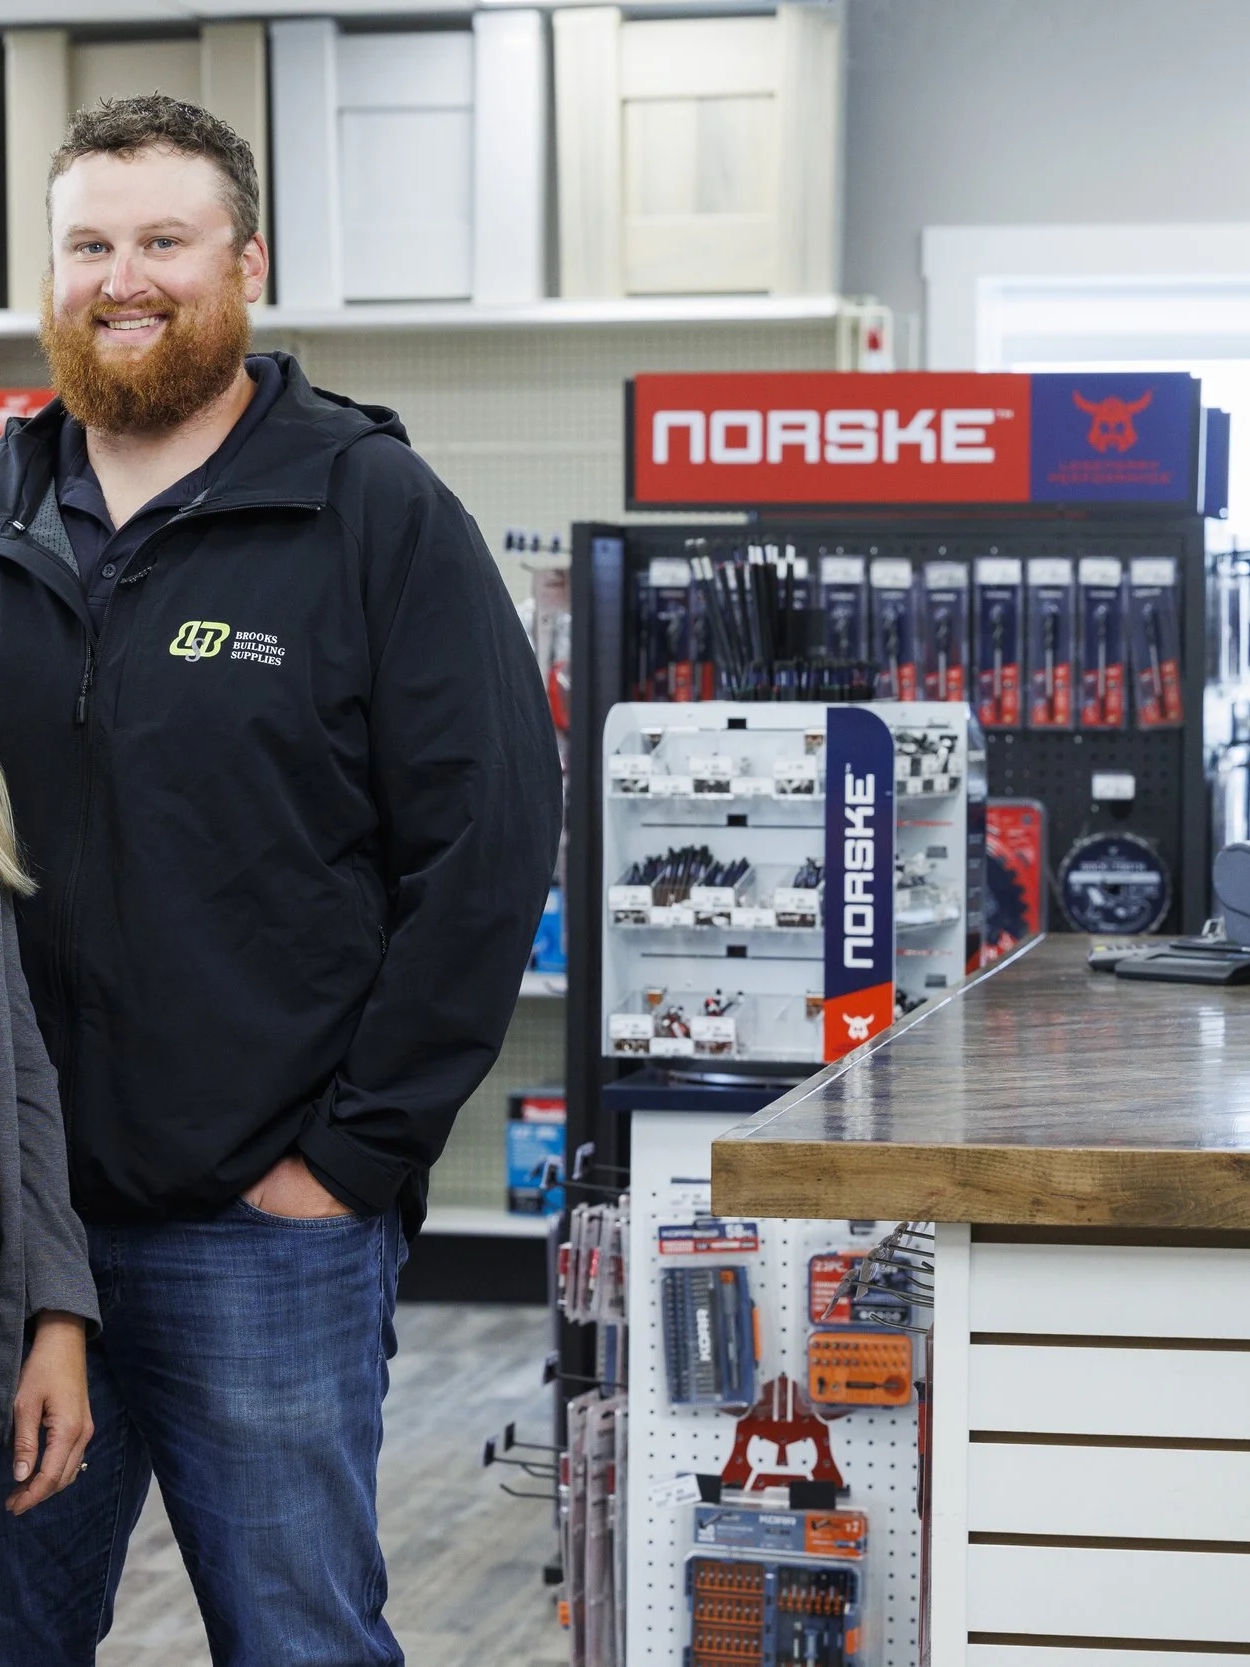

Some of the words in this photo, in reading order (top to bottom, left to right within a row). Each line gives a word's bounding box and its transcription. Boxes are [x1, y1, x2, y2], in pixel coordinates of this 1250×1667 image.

[652, 409, 997, 465] NORSKE
[235, 631, 278, 644] BROOKS
[232, 641, 286, 656] BUILDING
[230, 651, 282, 666] SUPPLIES
[843, 773, 876, 969] NORSKE
